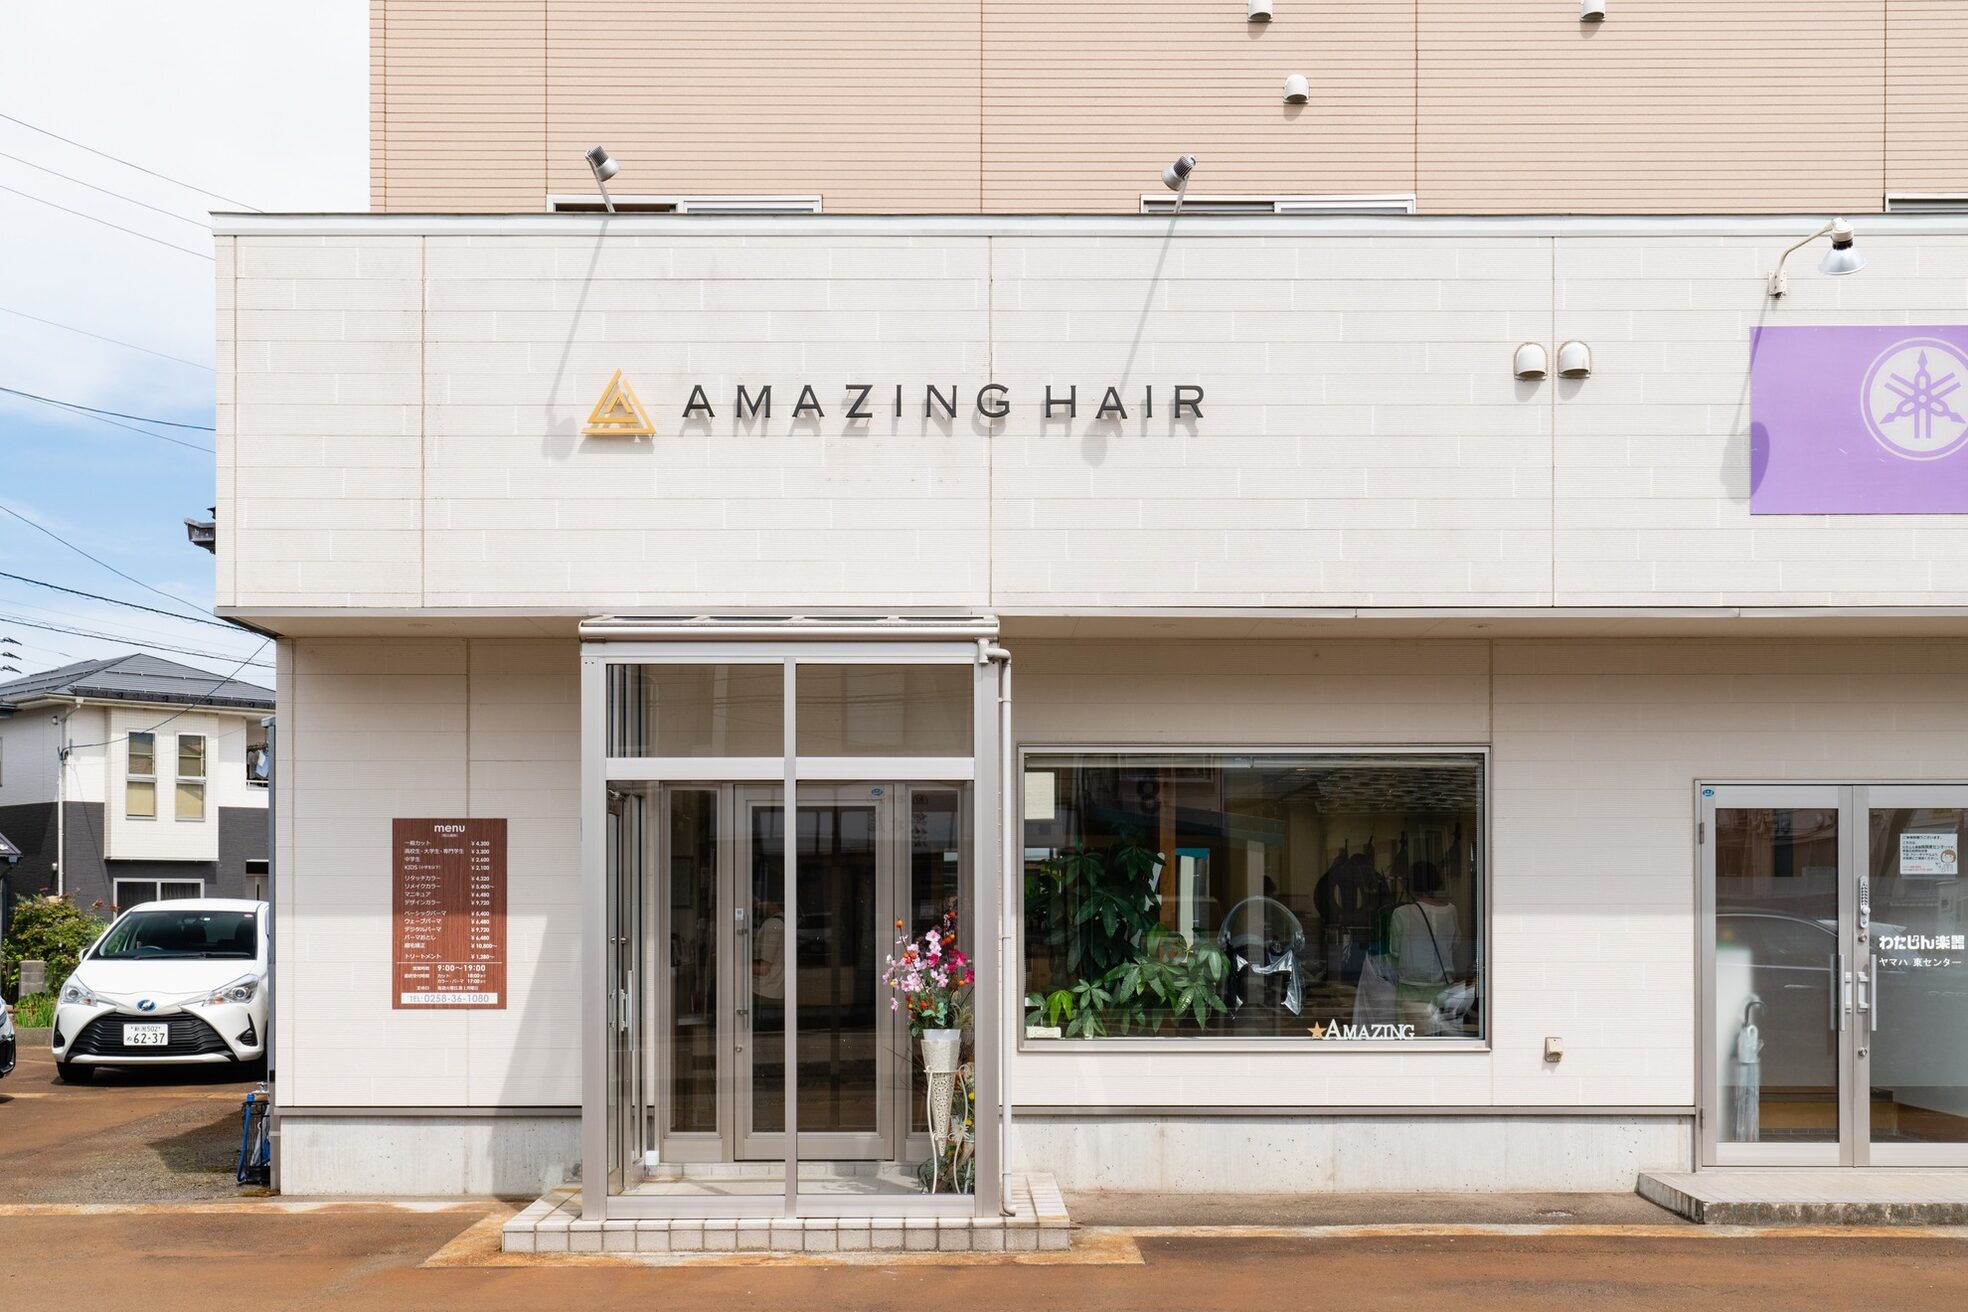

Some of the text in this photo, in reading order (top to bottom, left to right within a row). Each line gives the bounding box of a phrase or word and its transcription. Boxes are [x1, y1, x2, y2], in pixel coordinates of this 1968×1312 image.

[682, 384, 1206, 420] AMAZING HAIR
[434, 824, 466, 833] menu
[1878, 935, 1965, 950] わたじん楽器
[1879, 957, 1962, 967] ヤマハ 東センター
[423, 994, 490, 1003] 0258-36-1080
[1325, 1018, 1416, 1040] AMAZING
